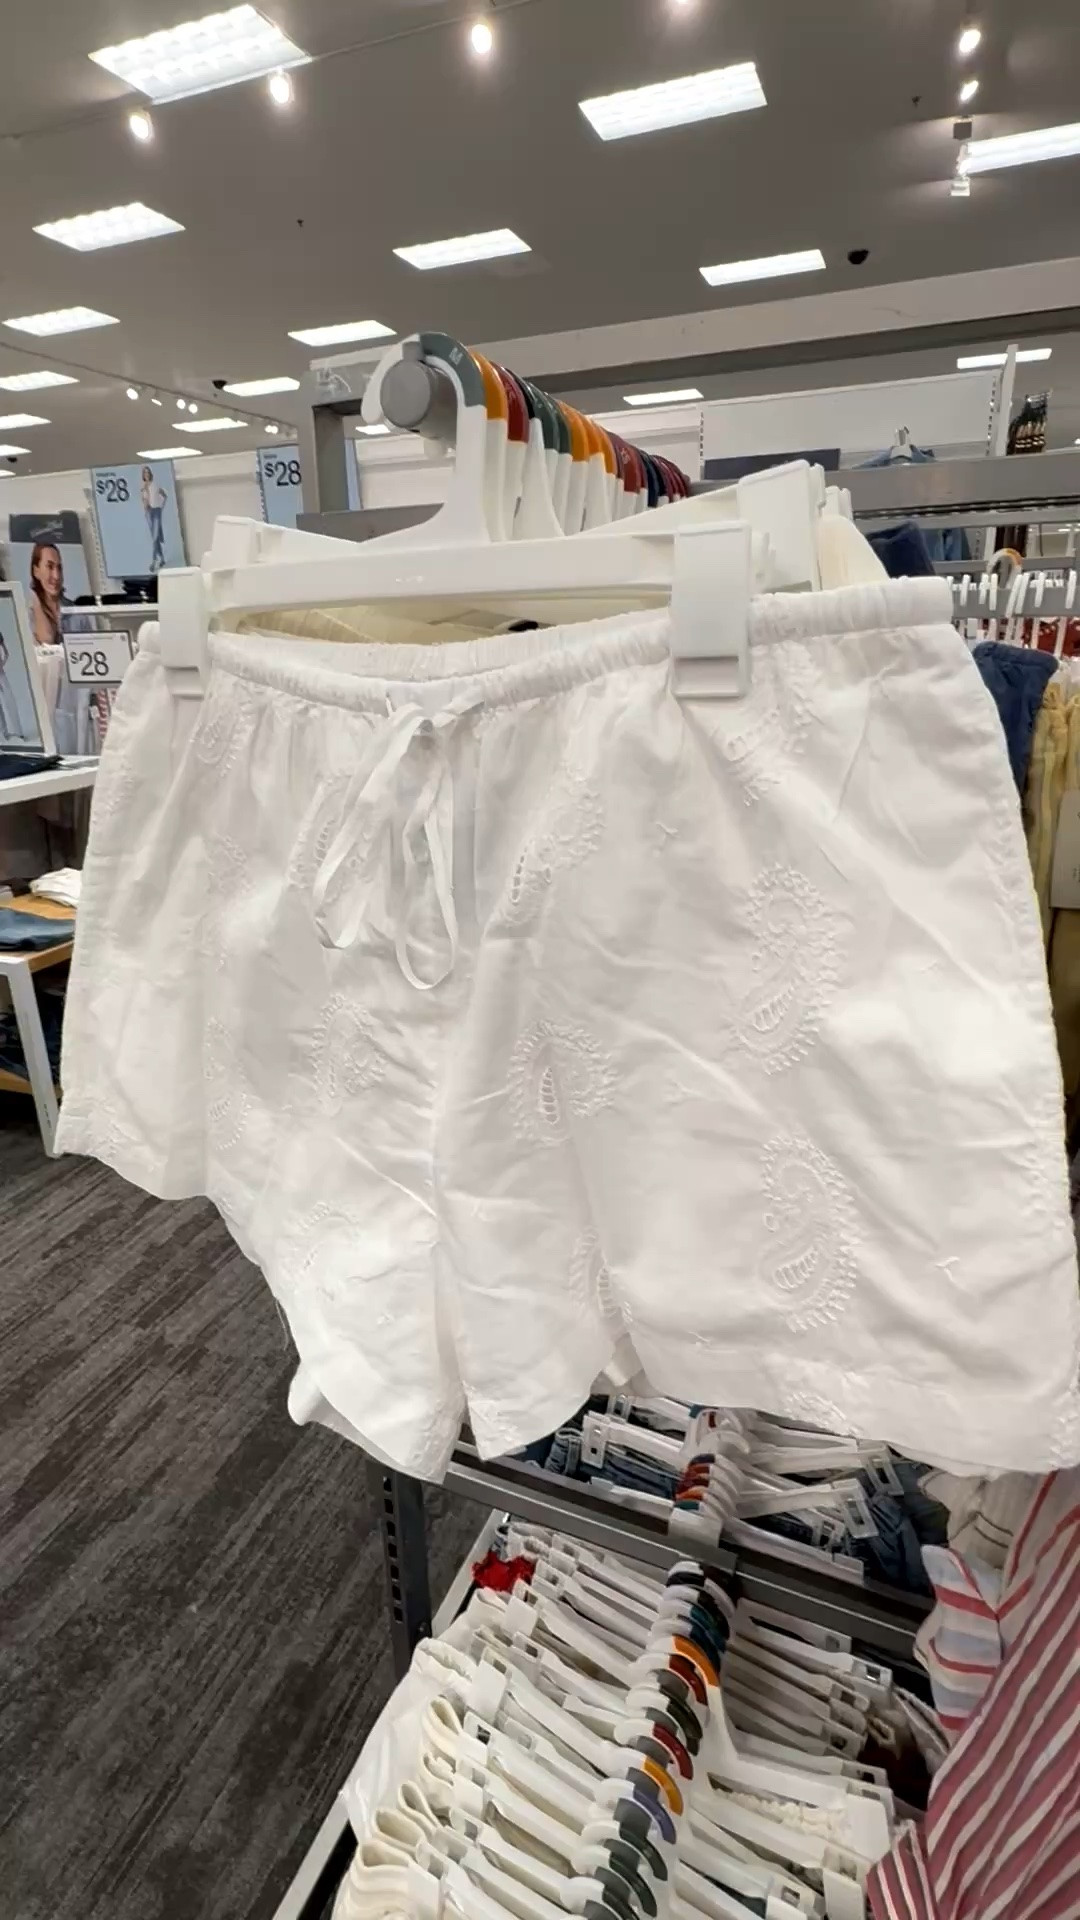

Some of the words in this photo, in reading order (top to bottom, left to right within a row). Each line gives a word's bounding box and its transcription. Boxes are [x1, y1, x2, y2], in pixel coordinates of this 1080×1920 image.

[263, 460, 302, 487] $28
[95, 478, 130, 503] $28
[70, 650, 109, 676] $28
